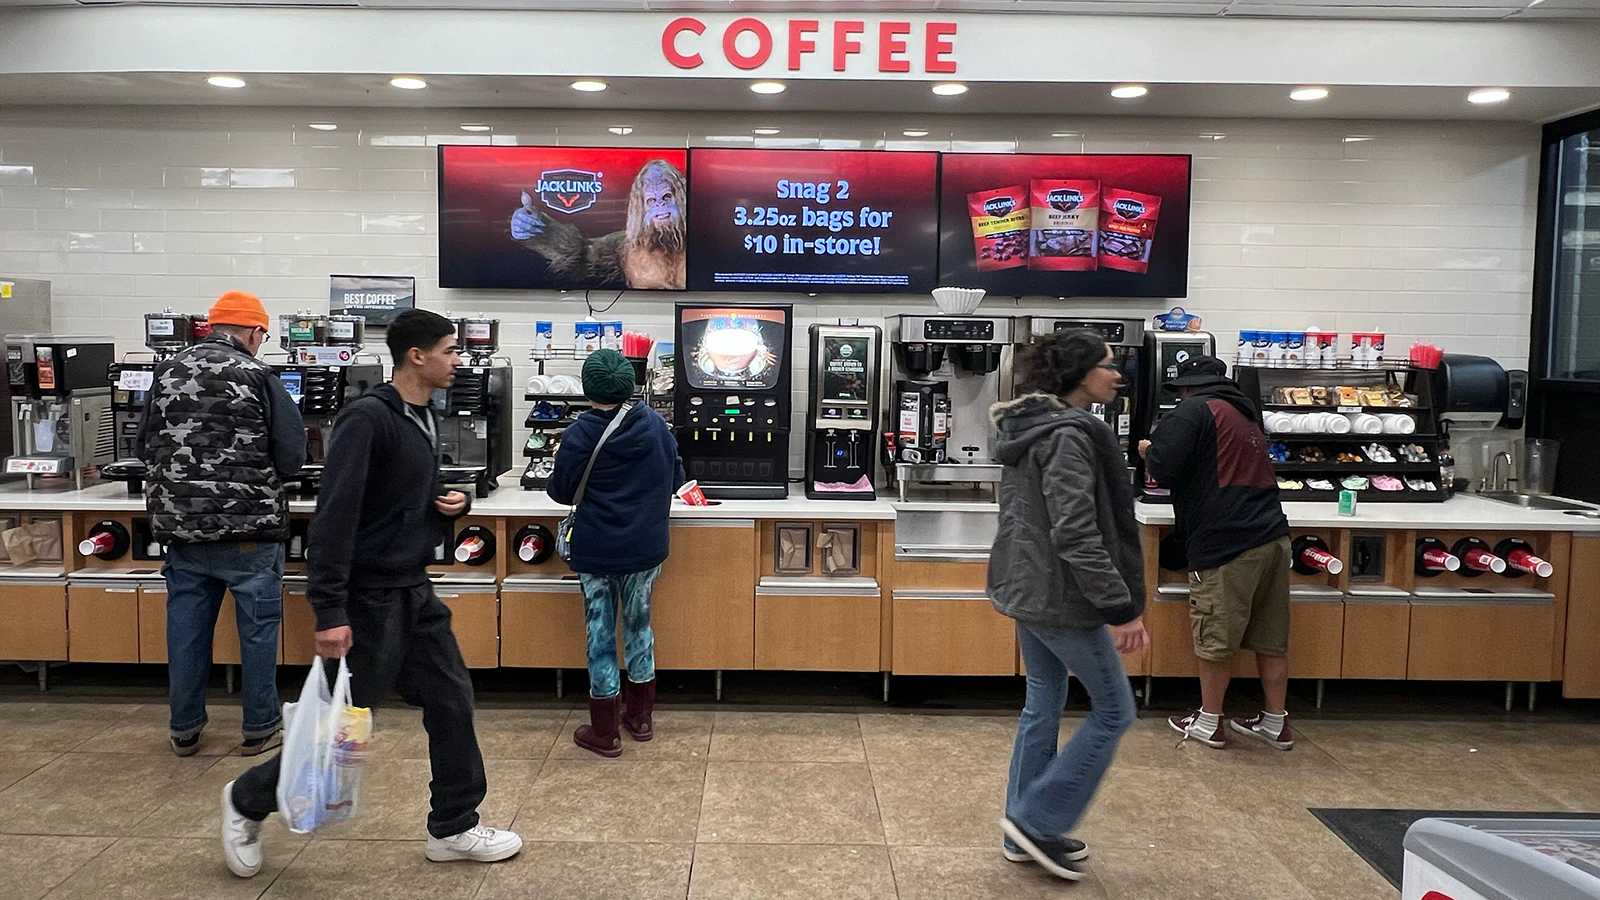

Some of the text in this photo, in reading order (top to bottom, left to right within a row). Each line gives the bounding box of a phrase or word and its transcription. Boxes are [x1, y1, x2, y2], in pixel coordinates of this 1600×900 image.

[661, 17, 957, 74] COFFEE
[534, 179, 567, 194] JACK
[776, 180, 851, 205] Snag 2
[734, 206, 893, 232] 3.25oz bags for
[744, 233, 881, 255] $10 in-store!
[344, 293, 397, 306] BEST COFFEE
